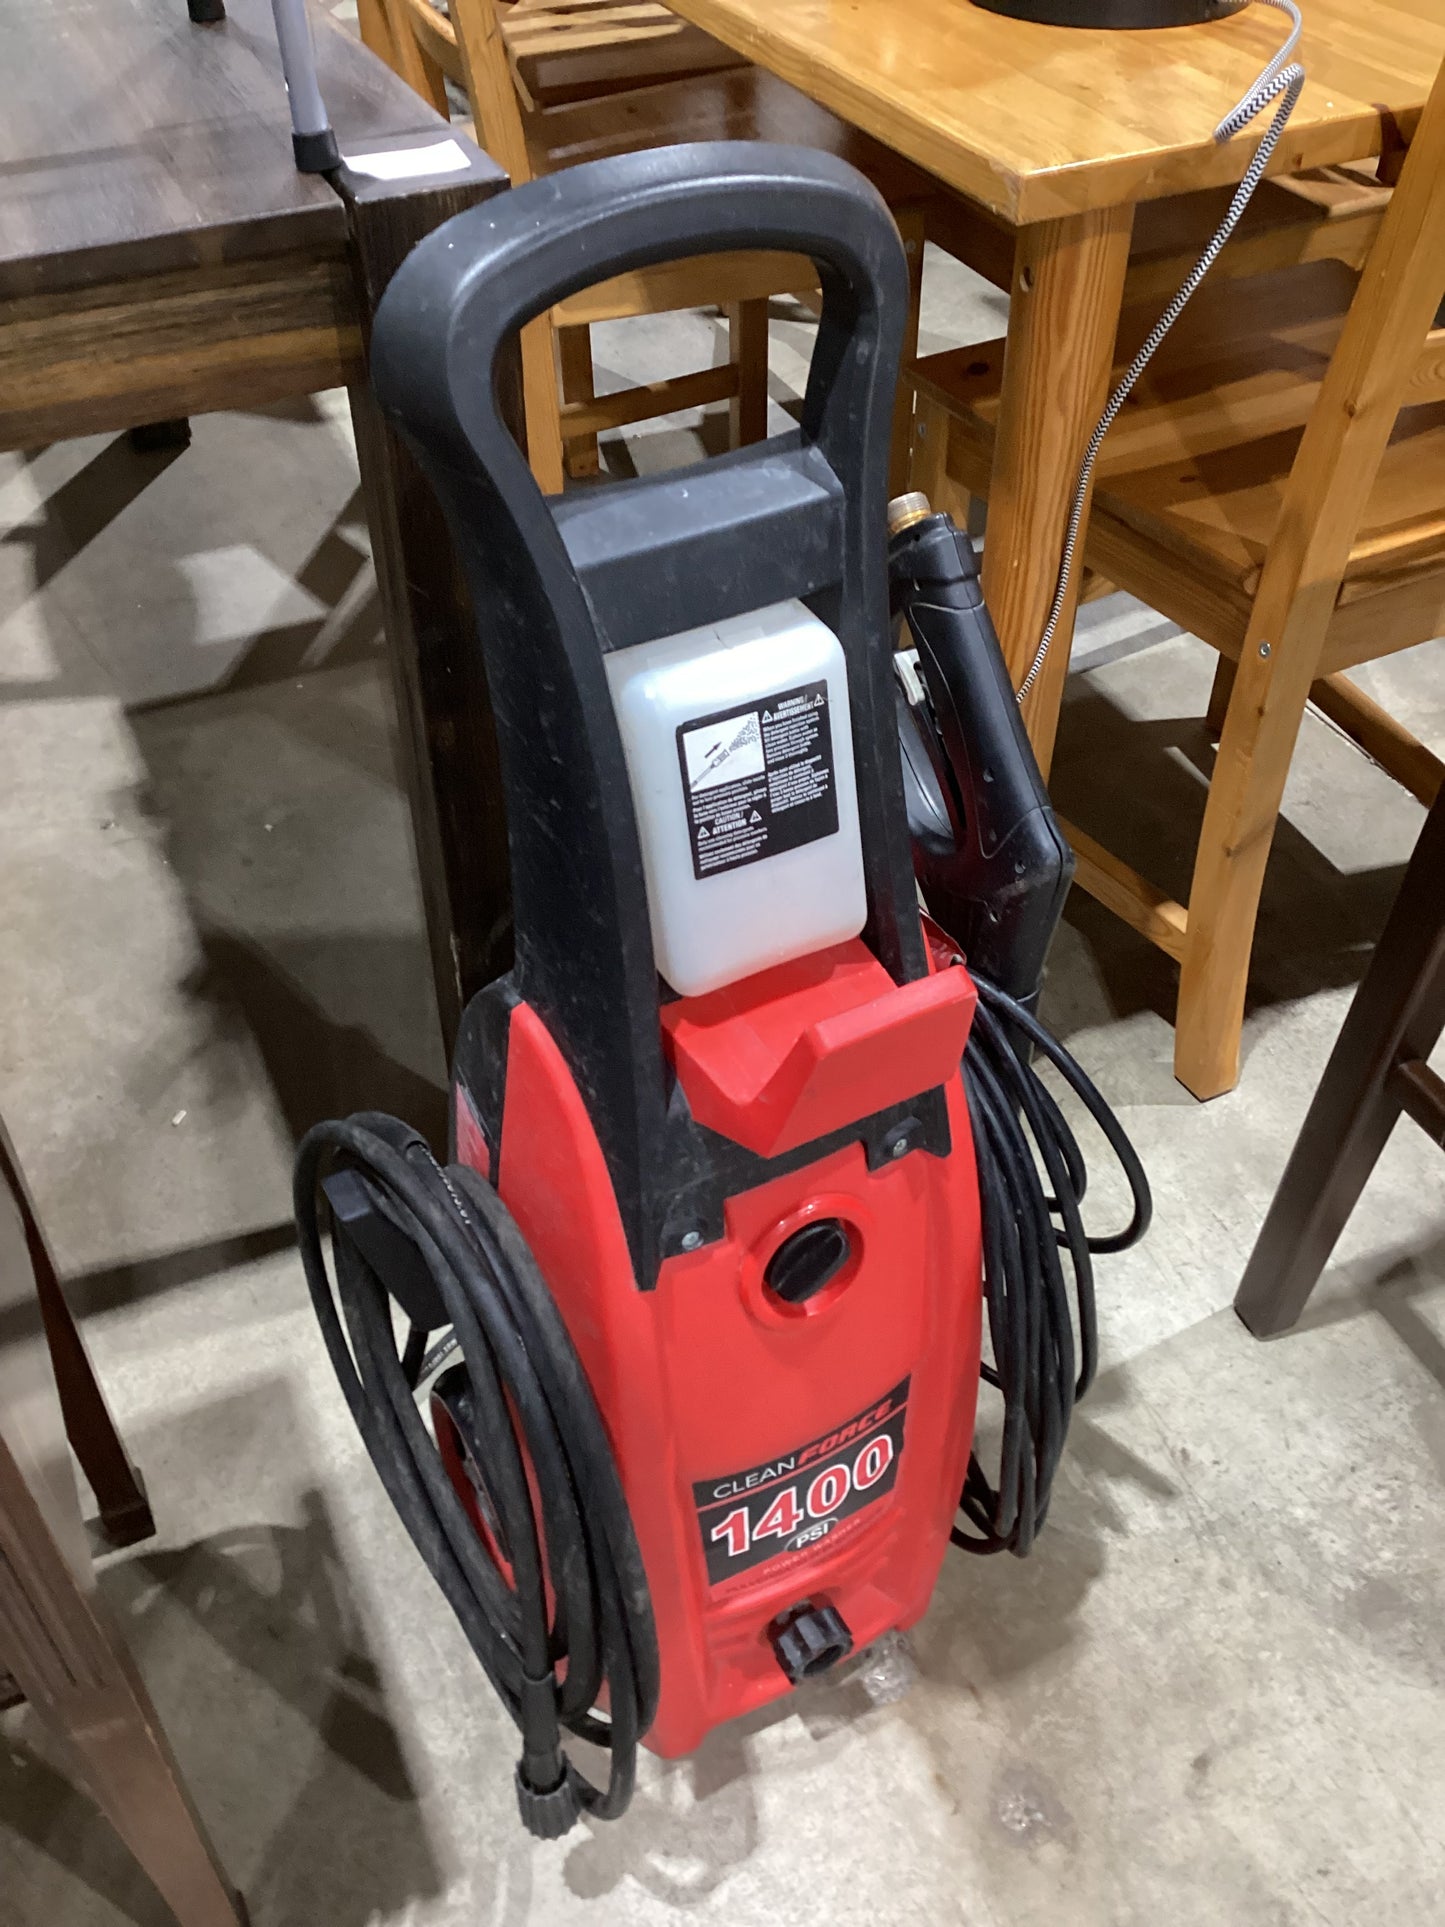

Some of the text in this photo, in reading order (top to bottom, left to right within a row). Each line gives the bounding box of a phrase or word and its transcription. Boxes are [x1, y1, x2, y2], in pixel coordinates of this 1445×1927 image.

[712, 818, 746, 834] ATTENTION
[714, 813, 740, 824] CAUTION
[713, 1398, 893, 1498] CLEAN FORCE
[711, 1434, 894, 1557] 1400
[796, 1523, 829, 1549] PSI
